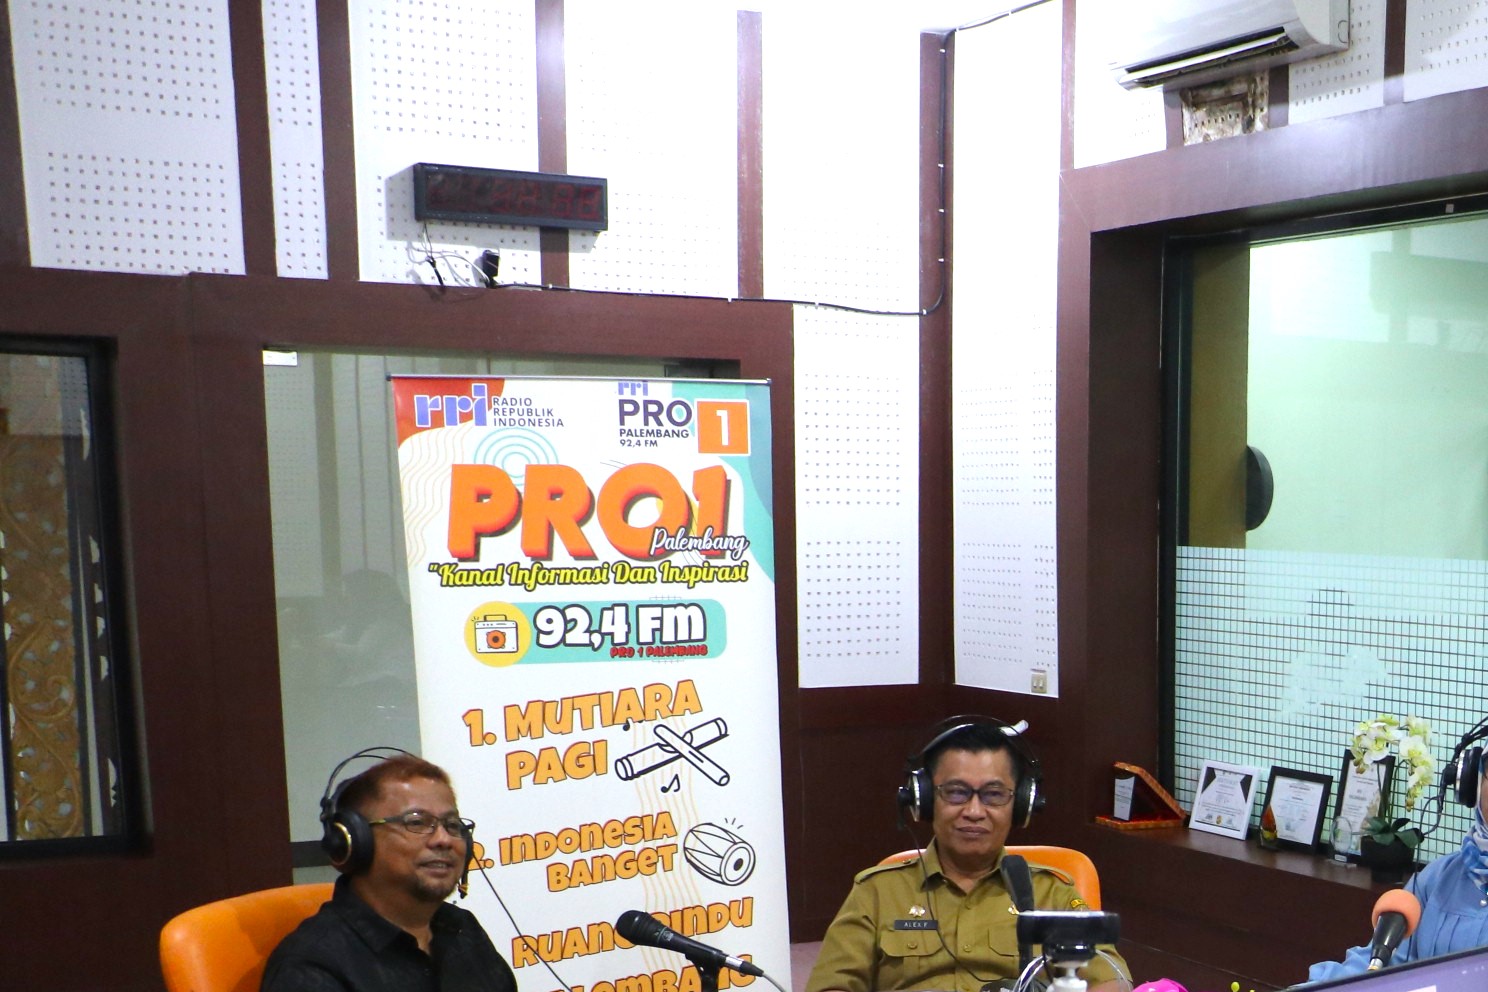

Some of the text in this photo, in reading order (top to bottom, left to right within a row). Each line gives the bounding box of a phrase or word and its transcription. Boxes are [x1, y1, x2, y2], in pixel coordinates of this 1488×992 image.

[414, 383, 488, 427] rri
[493, 397, 532, 406] RADIO
[493, 408, 554, 417] REPUBLIK
[493, 418, 564, 427] INDONESIA
[618, 399, 729, 446] PRO 1
[619, 428, 690, 438] PALEMBANG
[619, 439, 658, 448] 92,4 FM
[447, 463, 730, 561] PRO1
[650, 526, 750, 561] Palembang
[506, 561, 610, 592] Informasi
[611, 561, 657, 583] Dan
[659, 560, 749, 589] Inspirasi
[533, 603, 631, 651] 92,4
[610, 644, 708, 658] PRO 1 PALEMBANG
[462, 679, 703, 747] 1. MUTIARA
[505, 739, 608, 790] PAGI
